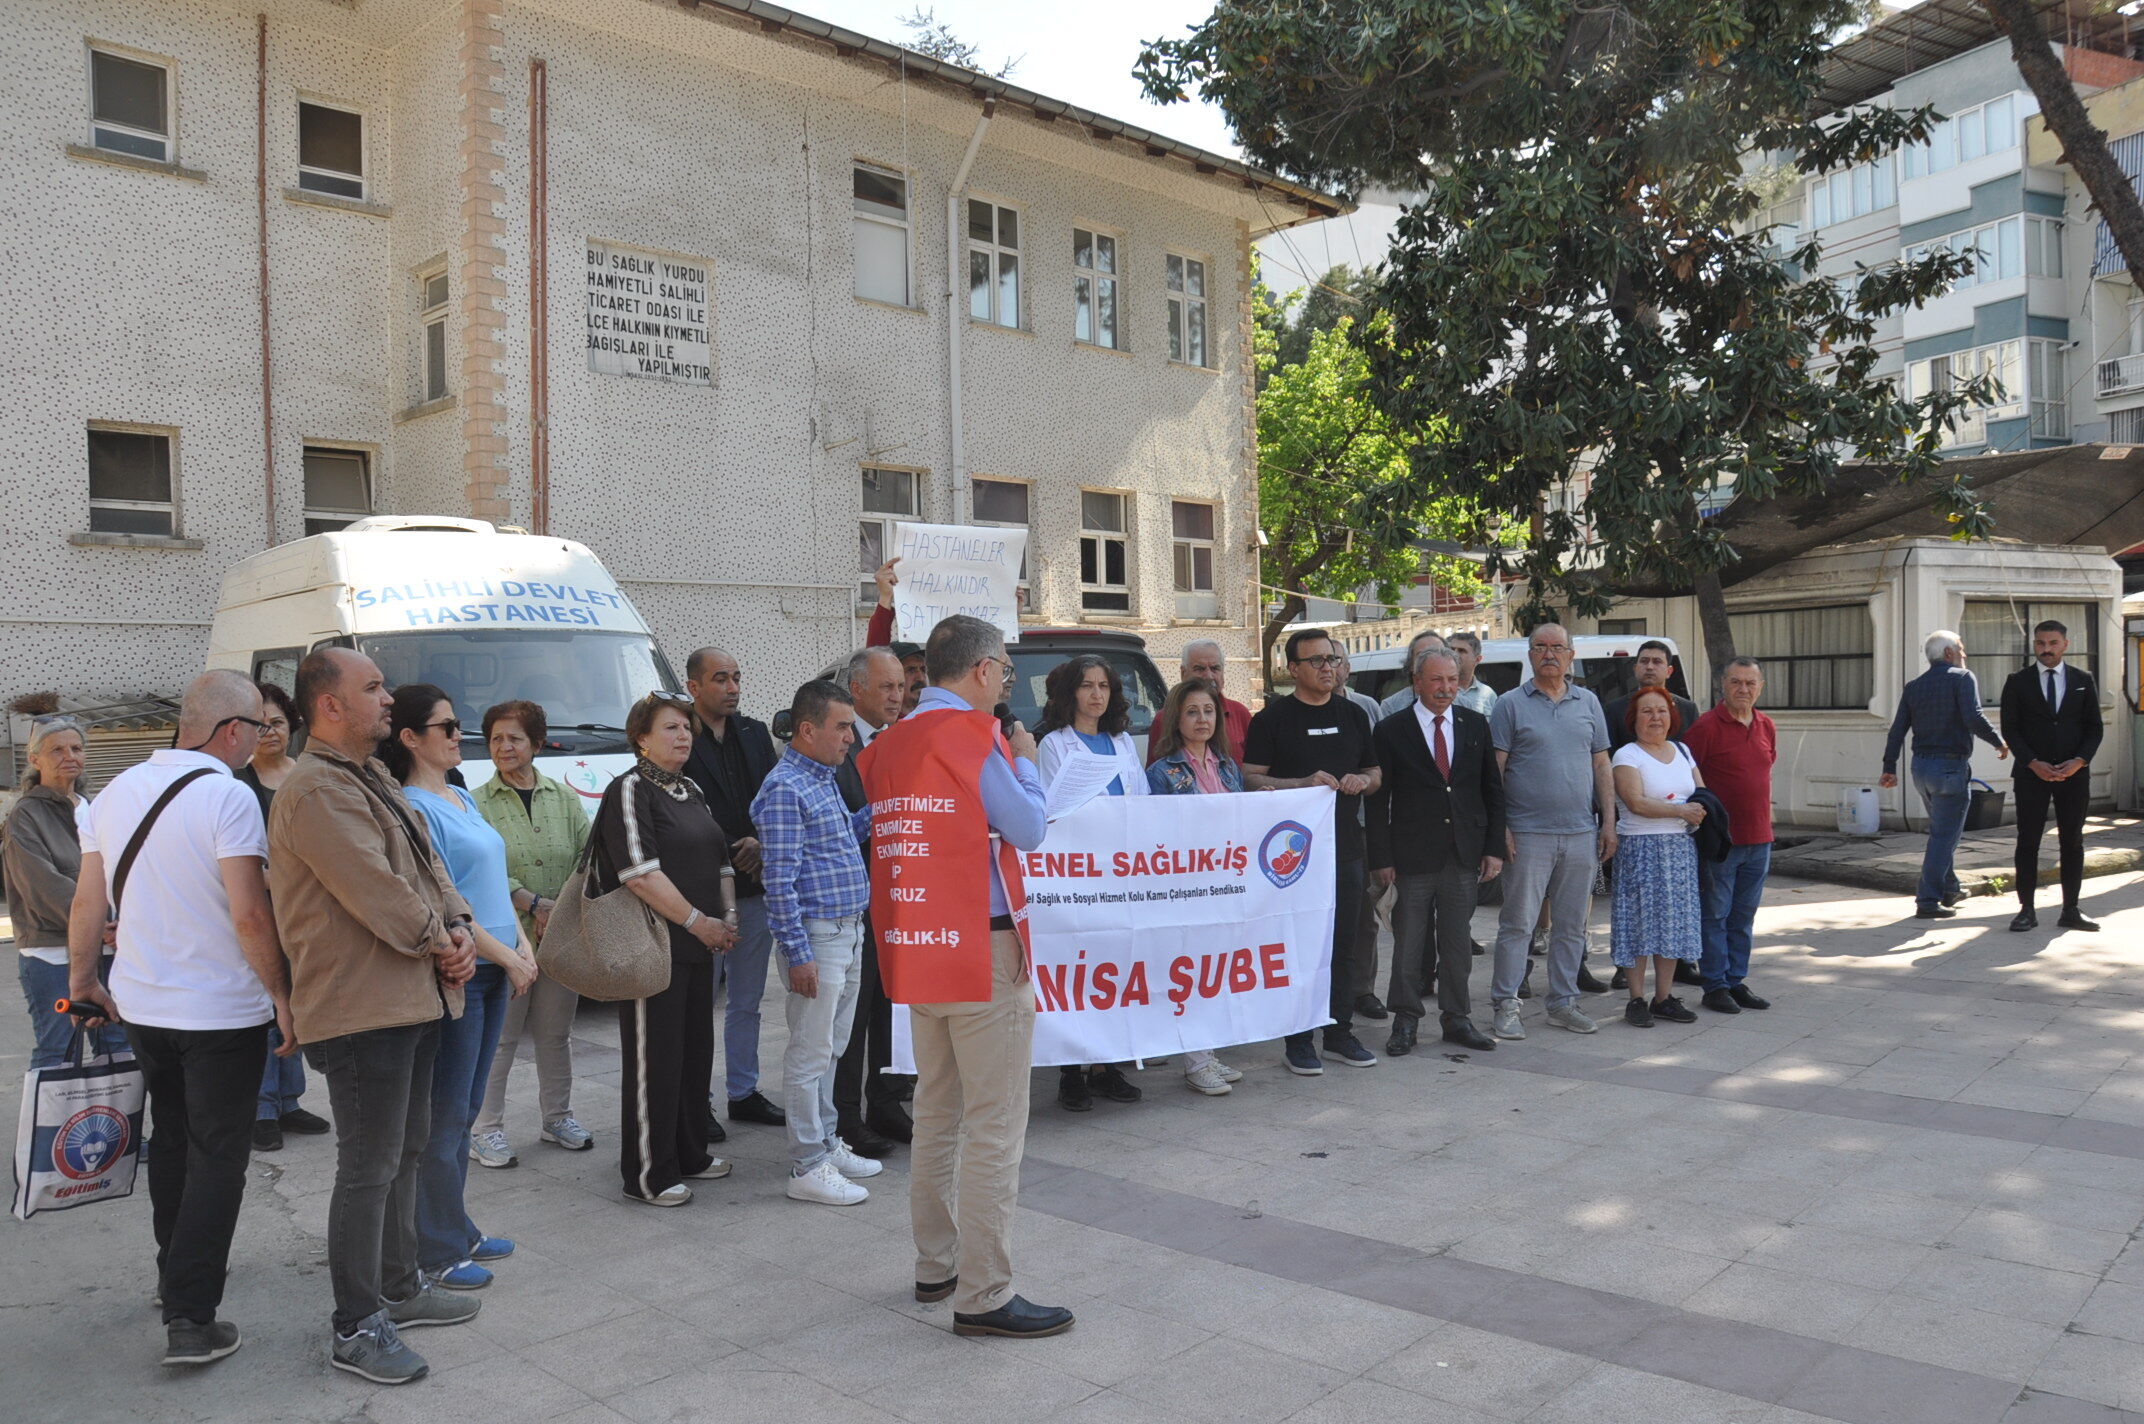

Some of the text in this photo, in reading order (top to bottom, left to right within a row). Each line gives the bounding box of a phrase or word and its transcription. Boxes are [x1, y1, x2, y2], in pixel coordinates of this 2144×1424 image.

[587, 250, 604, 266] BU
[664, 263, 704, 283] YURDU
[587, 271, 705, 303] HAMİYETLİ SALİHLİ
[588, 290, 705, 324] TİCARET ODASI İLE
[613, 317, 661, 338] HALKININ
[664, 326, 709, 344] KIYMETLİ
[655, 340, 674, 360] İLE
[638, 357, 710, 381] YAPILMIŞTIR
[901, 531, 1007, 566] HASTANELER
[355, 577, 622, 610] SALİHLİ DEVLET
[909, 571, 991, 597] HALKINDIR
[405, 603, 600, 626] HASTANESİ
[1112, 840, 1248, 877] SAĞLIK-İŞ
[1037, 892, 1061, 906] Sağlık
[1062, 895, 1072, 903] ve
[1072, 892, 1098, 906] Sosyal
[1099, 891, 1127, 903] Hizmet
[1128, 890, 1144, 902] Kolu
[1146, 890, 1167, 901] Kamu
[1169, 887, 1208, 902] Çalışanları
[1209, 884, 1246, 896] Sendikası
[1168, 943, 1290, 1016] ŞUBE
